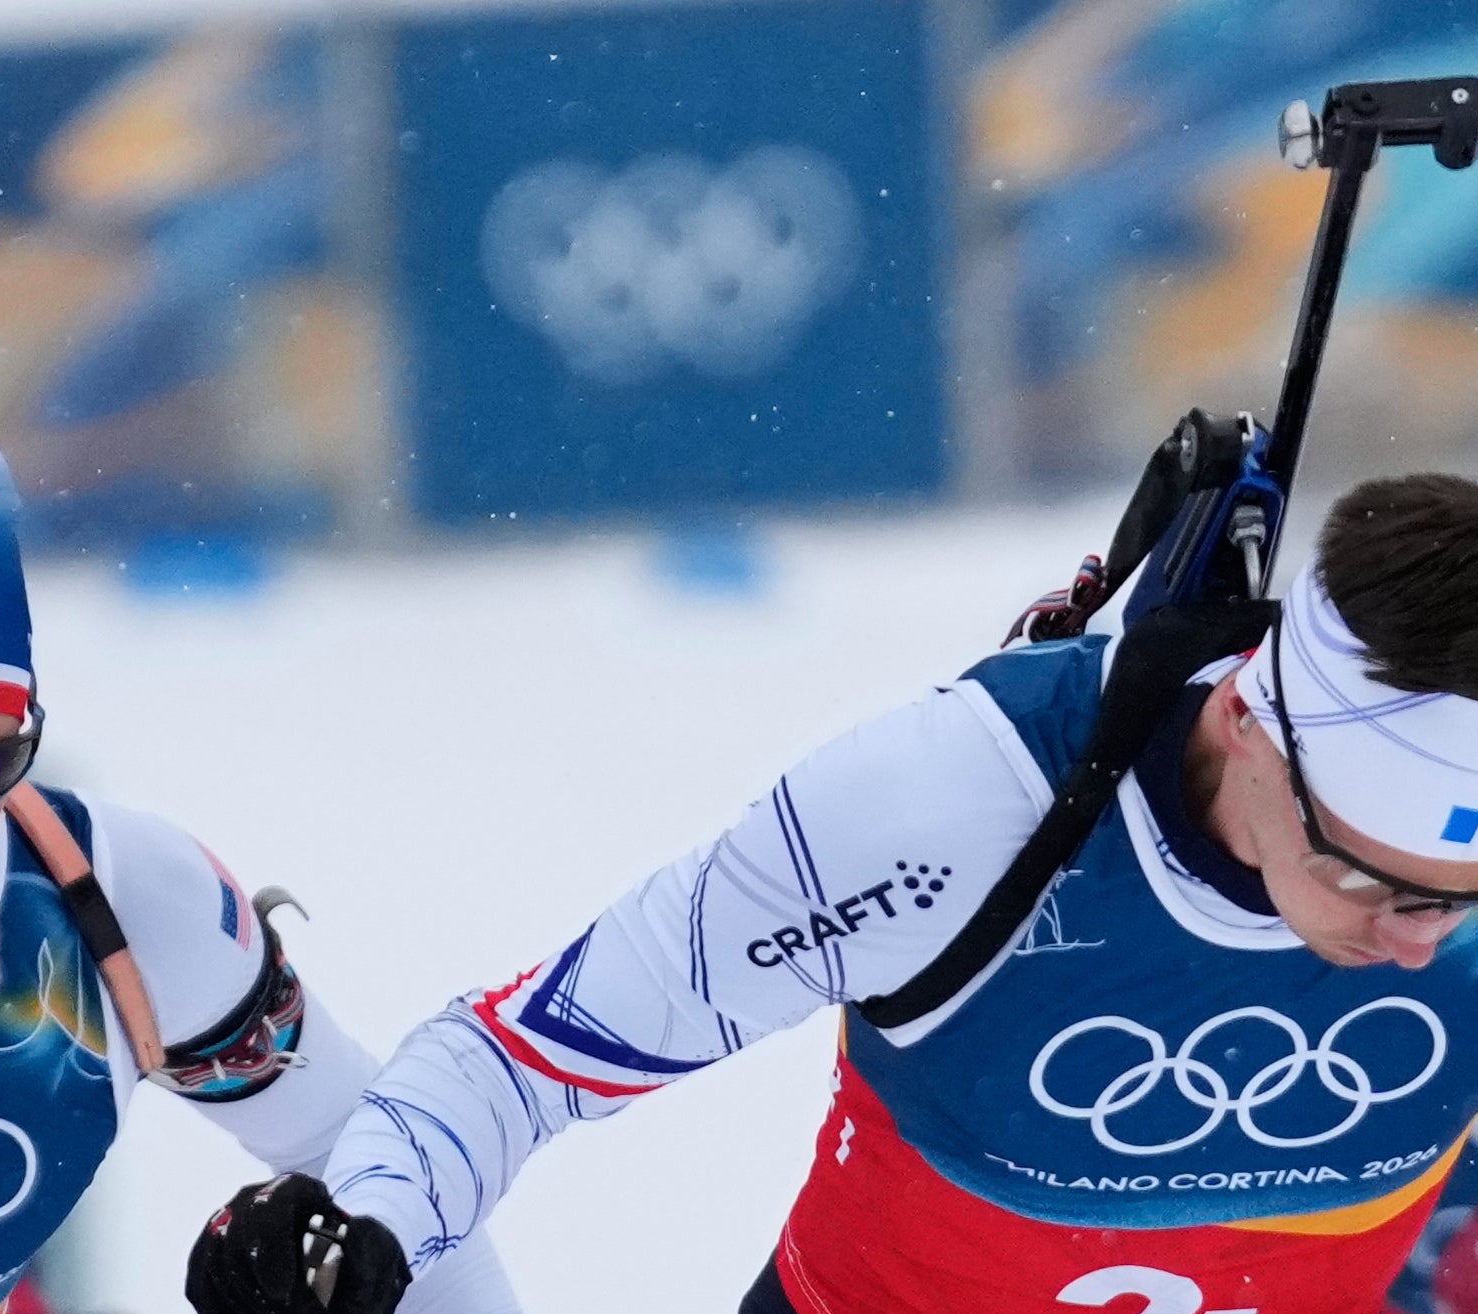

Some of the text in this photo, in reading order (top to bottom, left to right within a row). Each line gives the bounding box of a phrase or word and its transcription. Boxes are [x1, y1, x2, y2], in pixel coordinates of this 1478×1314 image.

[746, 880, 897, 968] CRAFT
[984, 1144, 1438, 1192] MILANO CORTINA 2026
